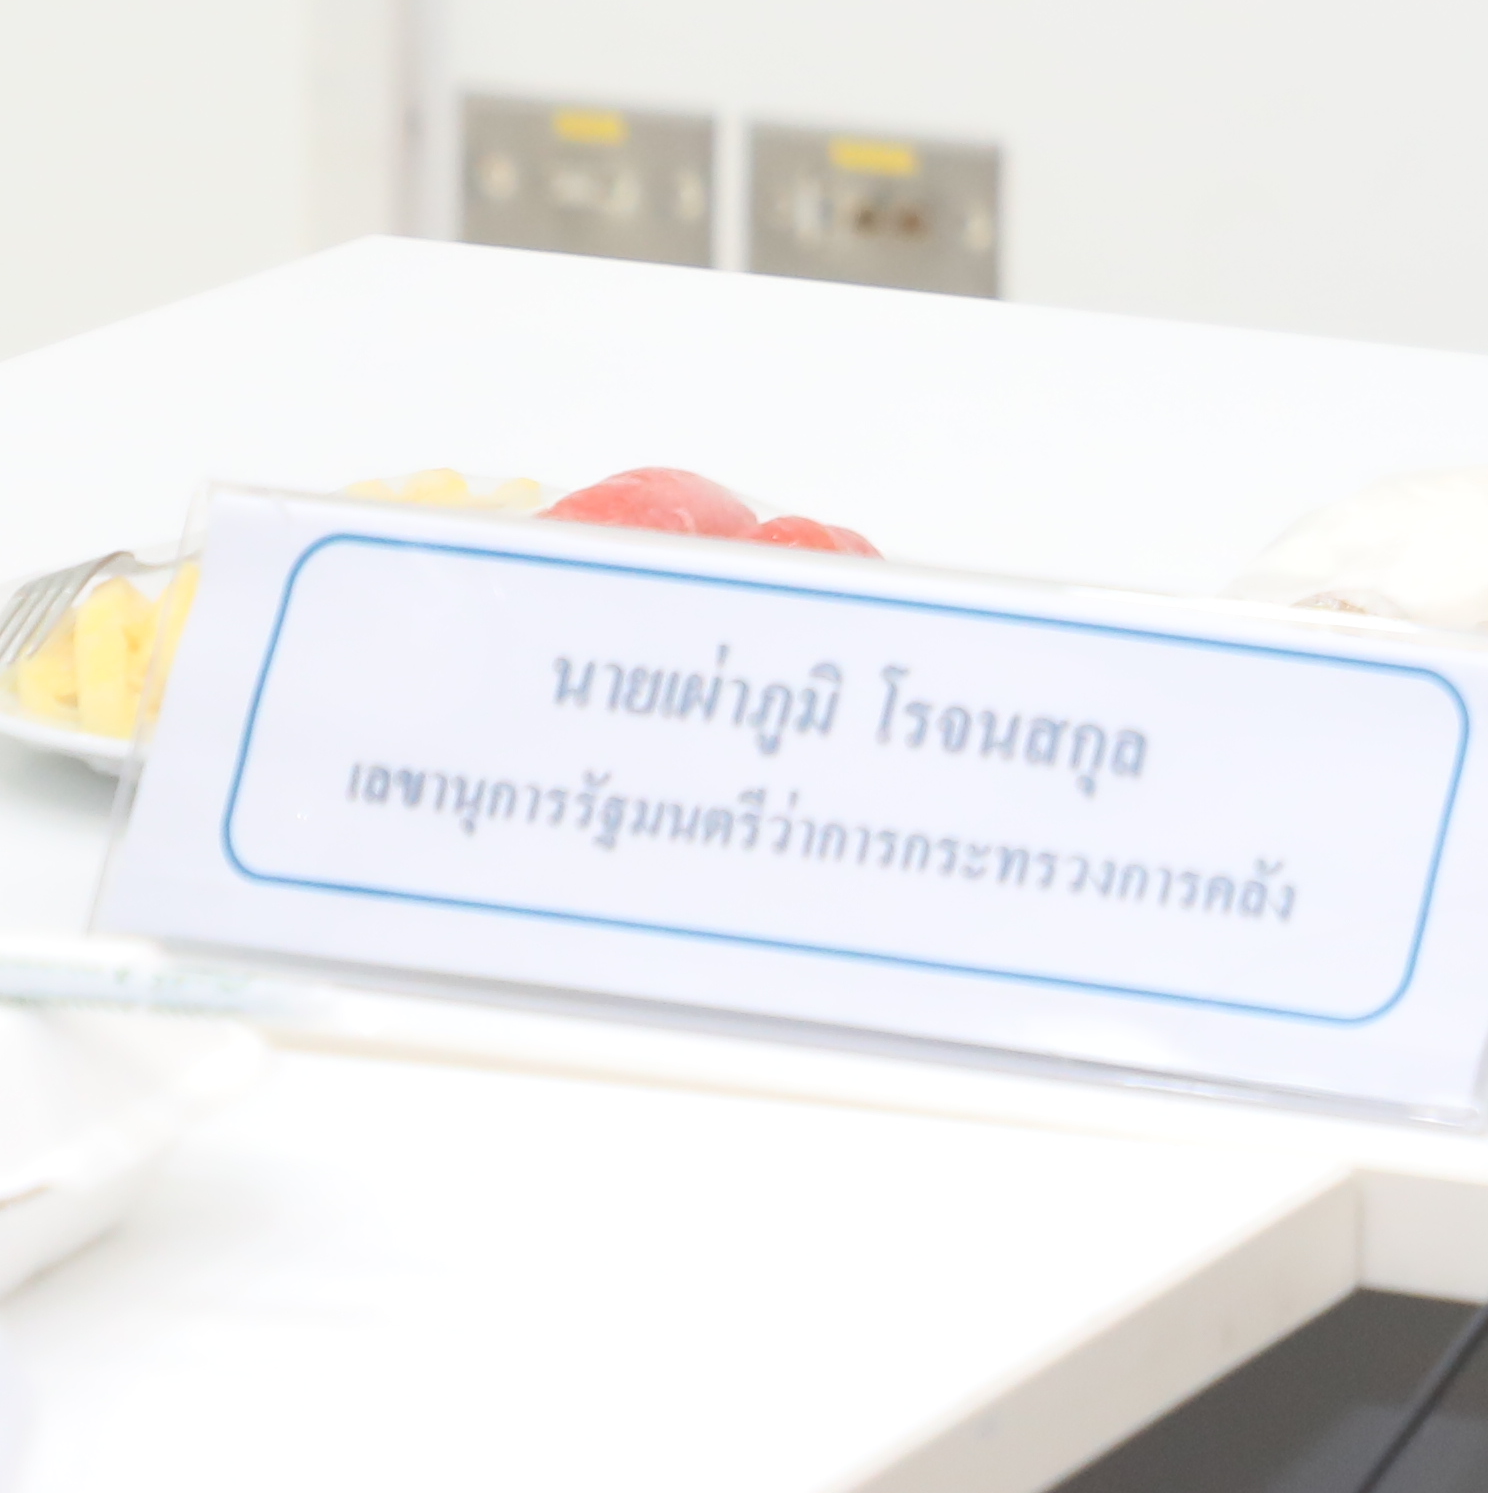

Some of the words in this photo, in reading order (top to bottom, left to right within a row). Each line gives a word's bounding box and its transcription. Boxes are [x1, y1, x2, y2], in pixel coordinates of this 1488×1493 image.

[551, 644, 843, 755] นายเผ่าภูมิ
[876, 664, 1148, 797] โรจนสกุล
[346, 761, 1297, 921] เลขานุการรัฐมนตรีว่าการกระทรวงการคลัง
